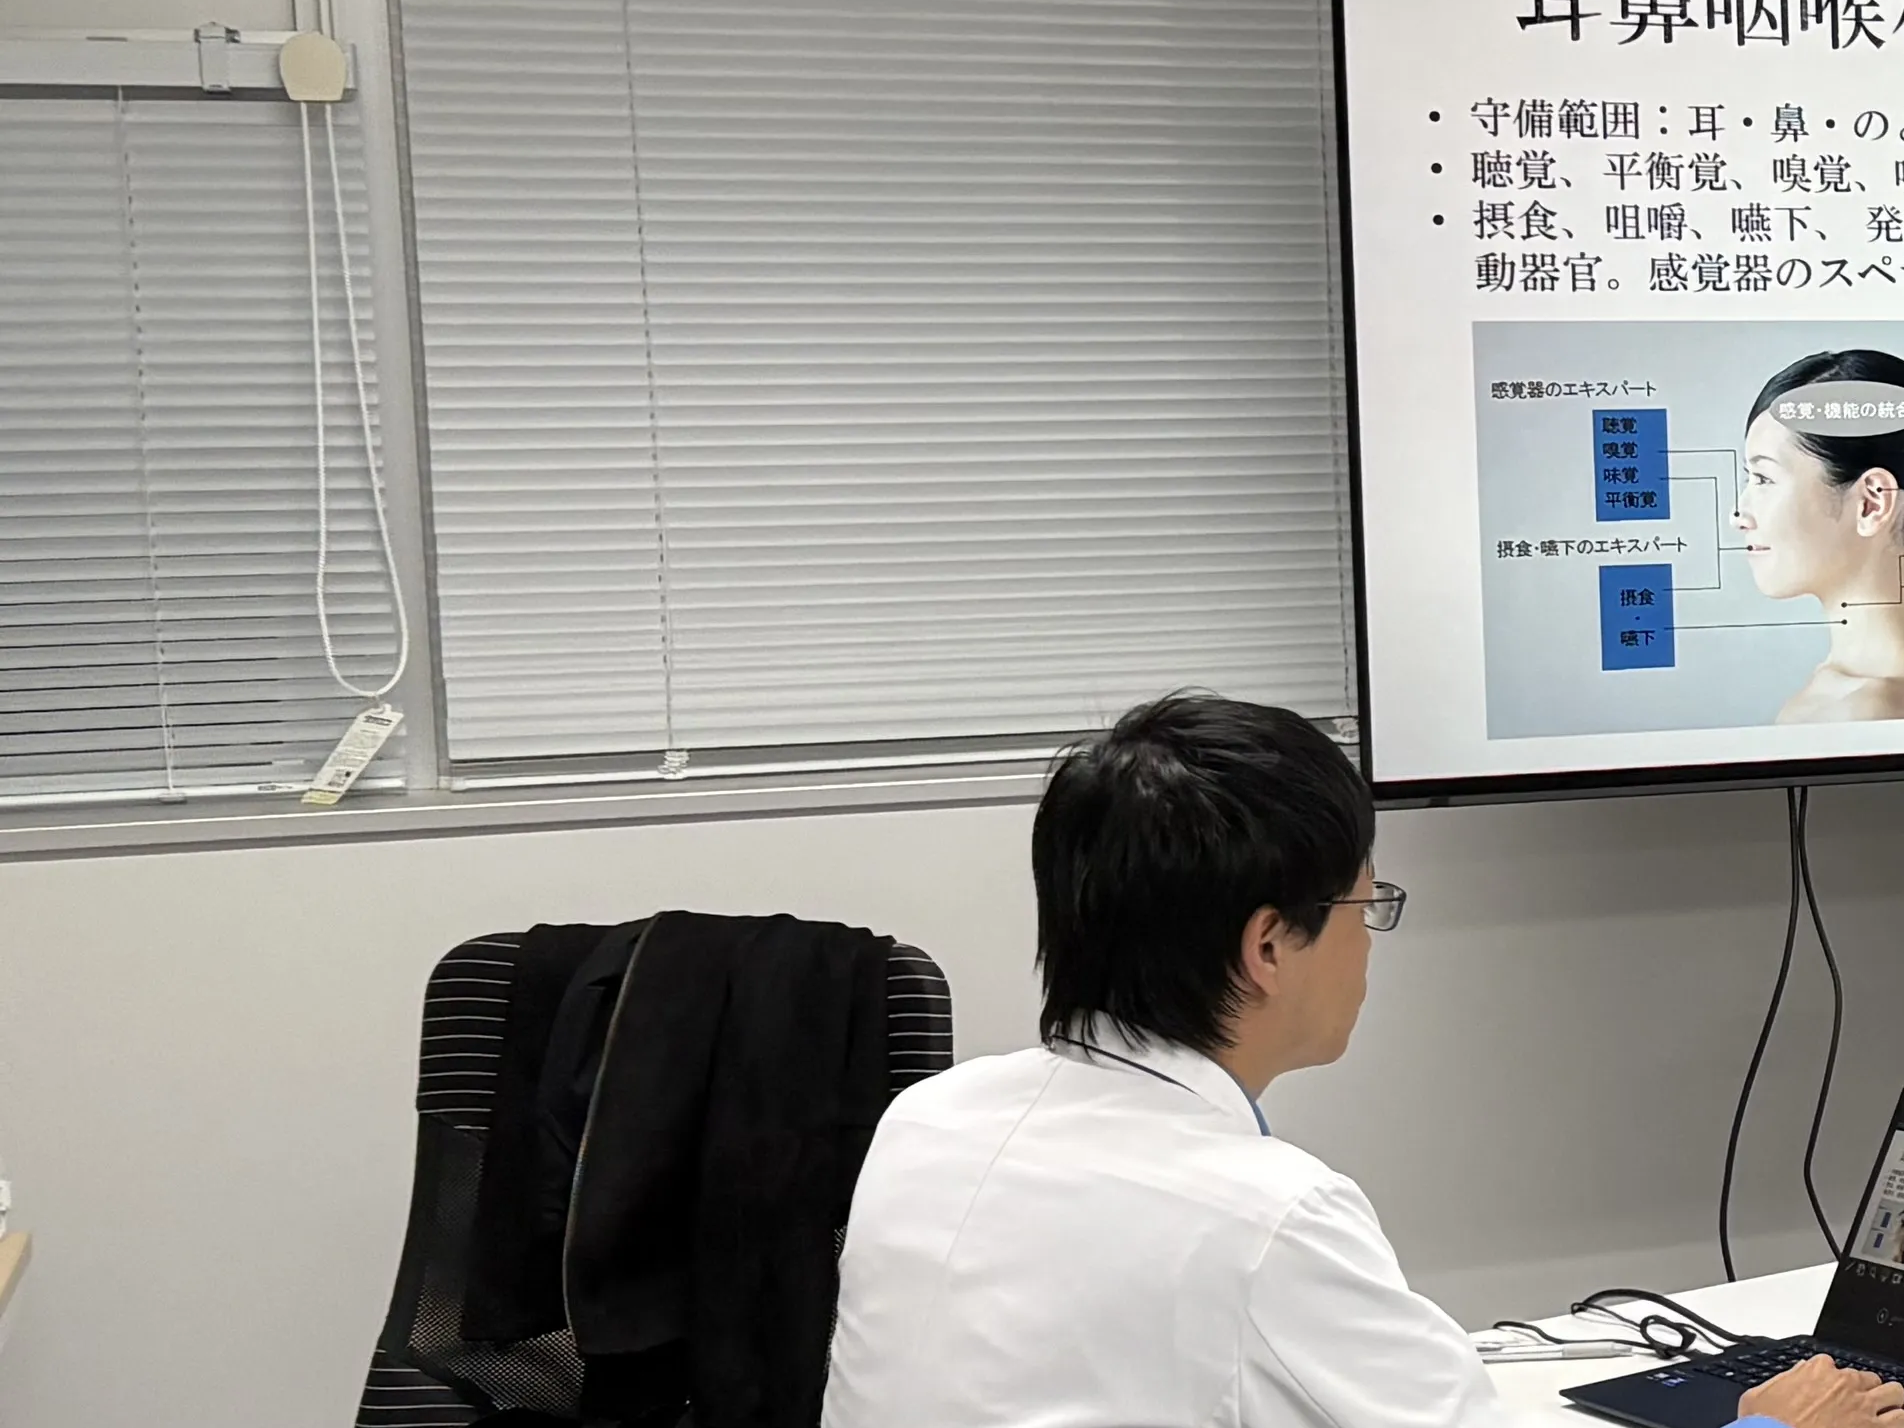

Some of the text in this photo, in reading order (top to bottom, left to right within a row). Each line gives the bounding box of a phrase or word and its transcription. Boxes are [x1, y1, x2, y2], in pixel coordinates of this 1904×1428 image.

[1491, 379, 1658, 400] 感覚器のエキスパート
[1602, 417, 1638, 435] 聴覚
[1603, 467, 1640, 485] 味覚
[1604, 491, 1659, 510] 平衡覚
[1620, 588, 1656, 608] 摂食
